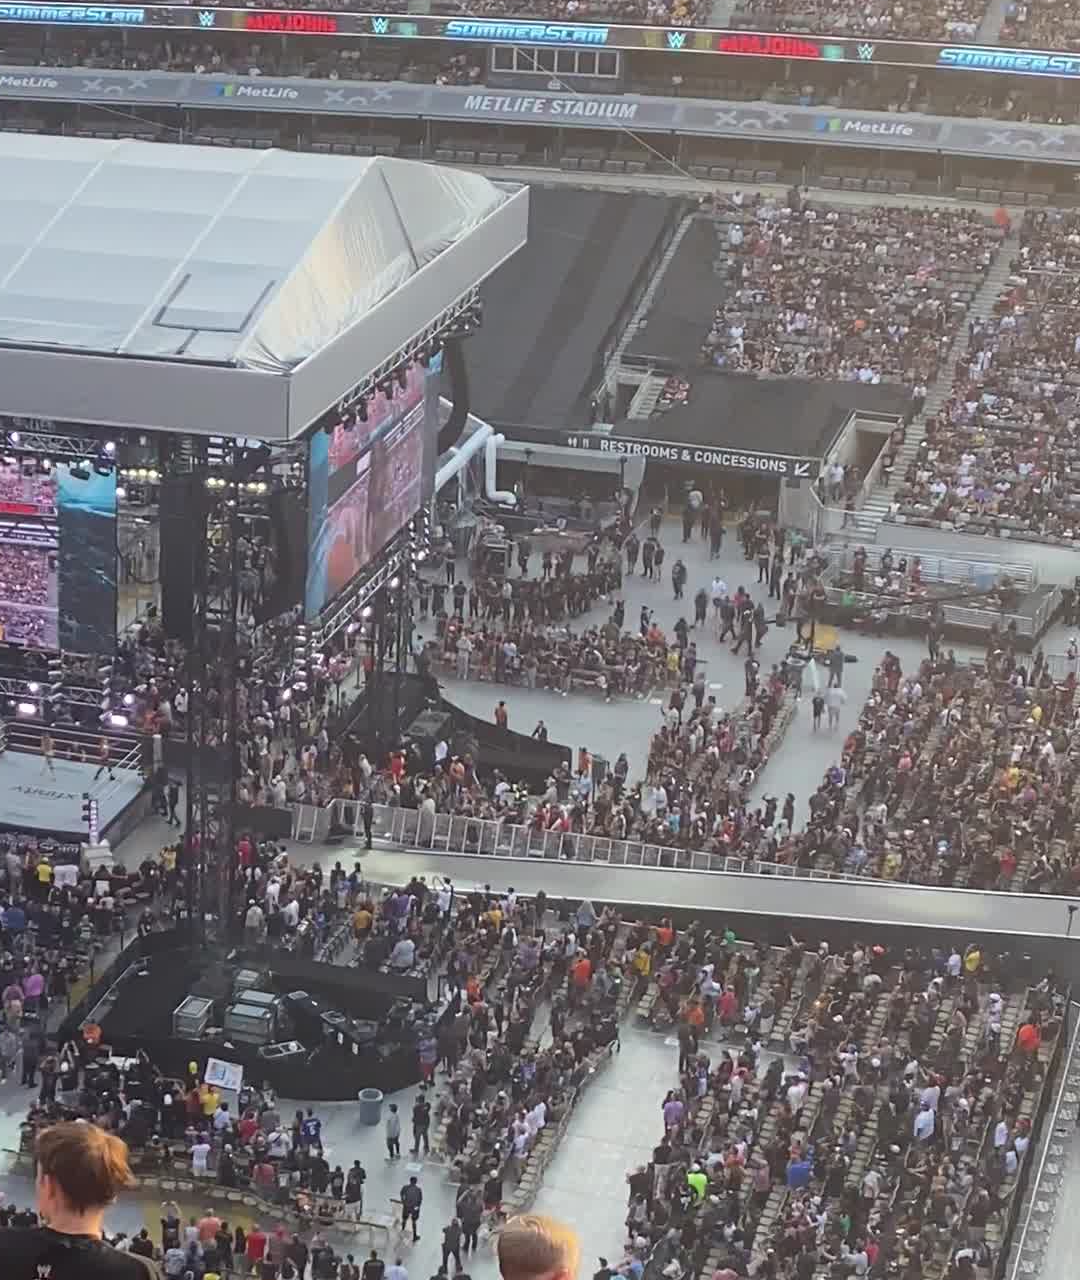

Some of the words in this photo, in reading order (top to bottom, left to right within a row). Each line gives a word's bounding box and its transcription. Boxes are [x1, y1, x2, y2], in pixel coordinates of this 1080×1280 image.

[444, 20, 610, 46] SUMMERSLAM
[236, 85, 299, 99] MetLife
[463, 95, 547, 114] METLIFE
[550, 99, 639, 119] STADIUM
[843, 120, 914, 136] MetLife
[600, 439, 679, 462] RESTROOMS
[681, 448, 691, 462] &
[694, 449, 788, 473] CONCESSIONS
